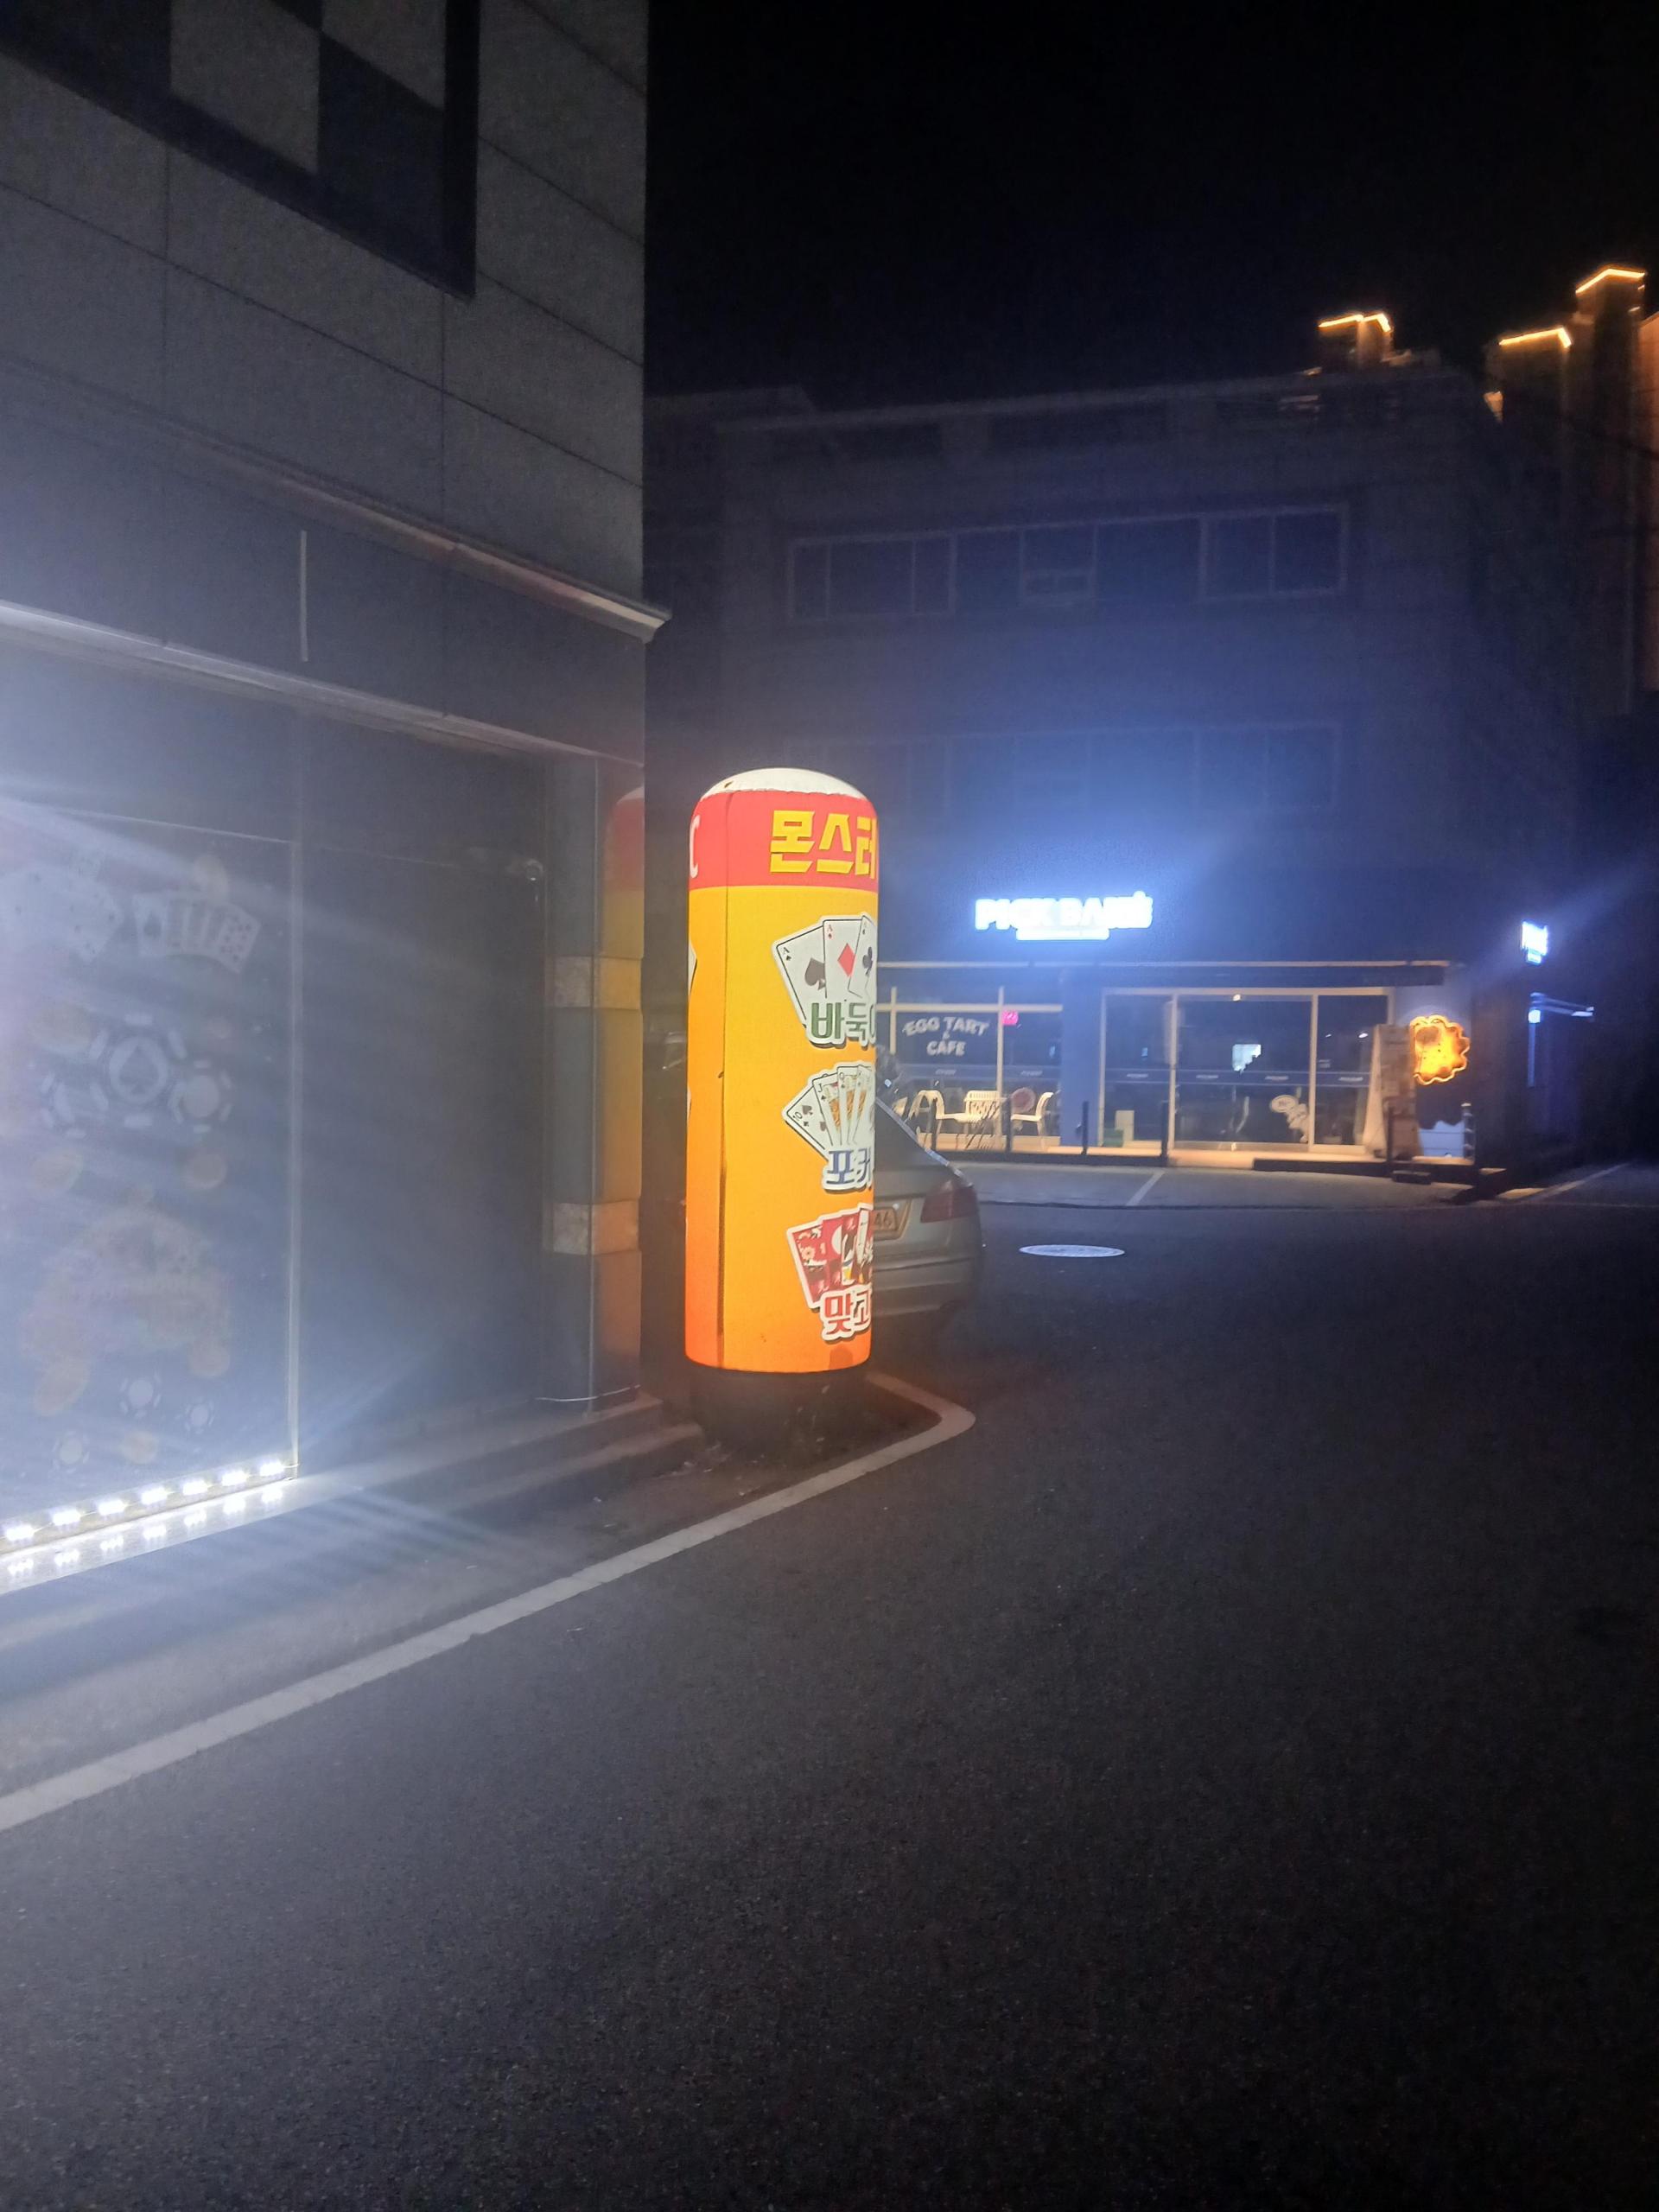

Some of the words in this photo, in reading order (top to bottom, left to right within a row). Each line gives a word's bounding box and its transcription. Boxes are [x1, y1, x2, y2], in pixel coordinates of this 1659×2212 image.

[902, 1017, 940, 1037] EGG
[944, 1016, 989, 1036] TART
[926, 1040, 966, 1057] CAFE
